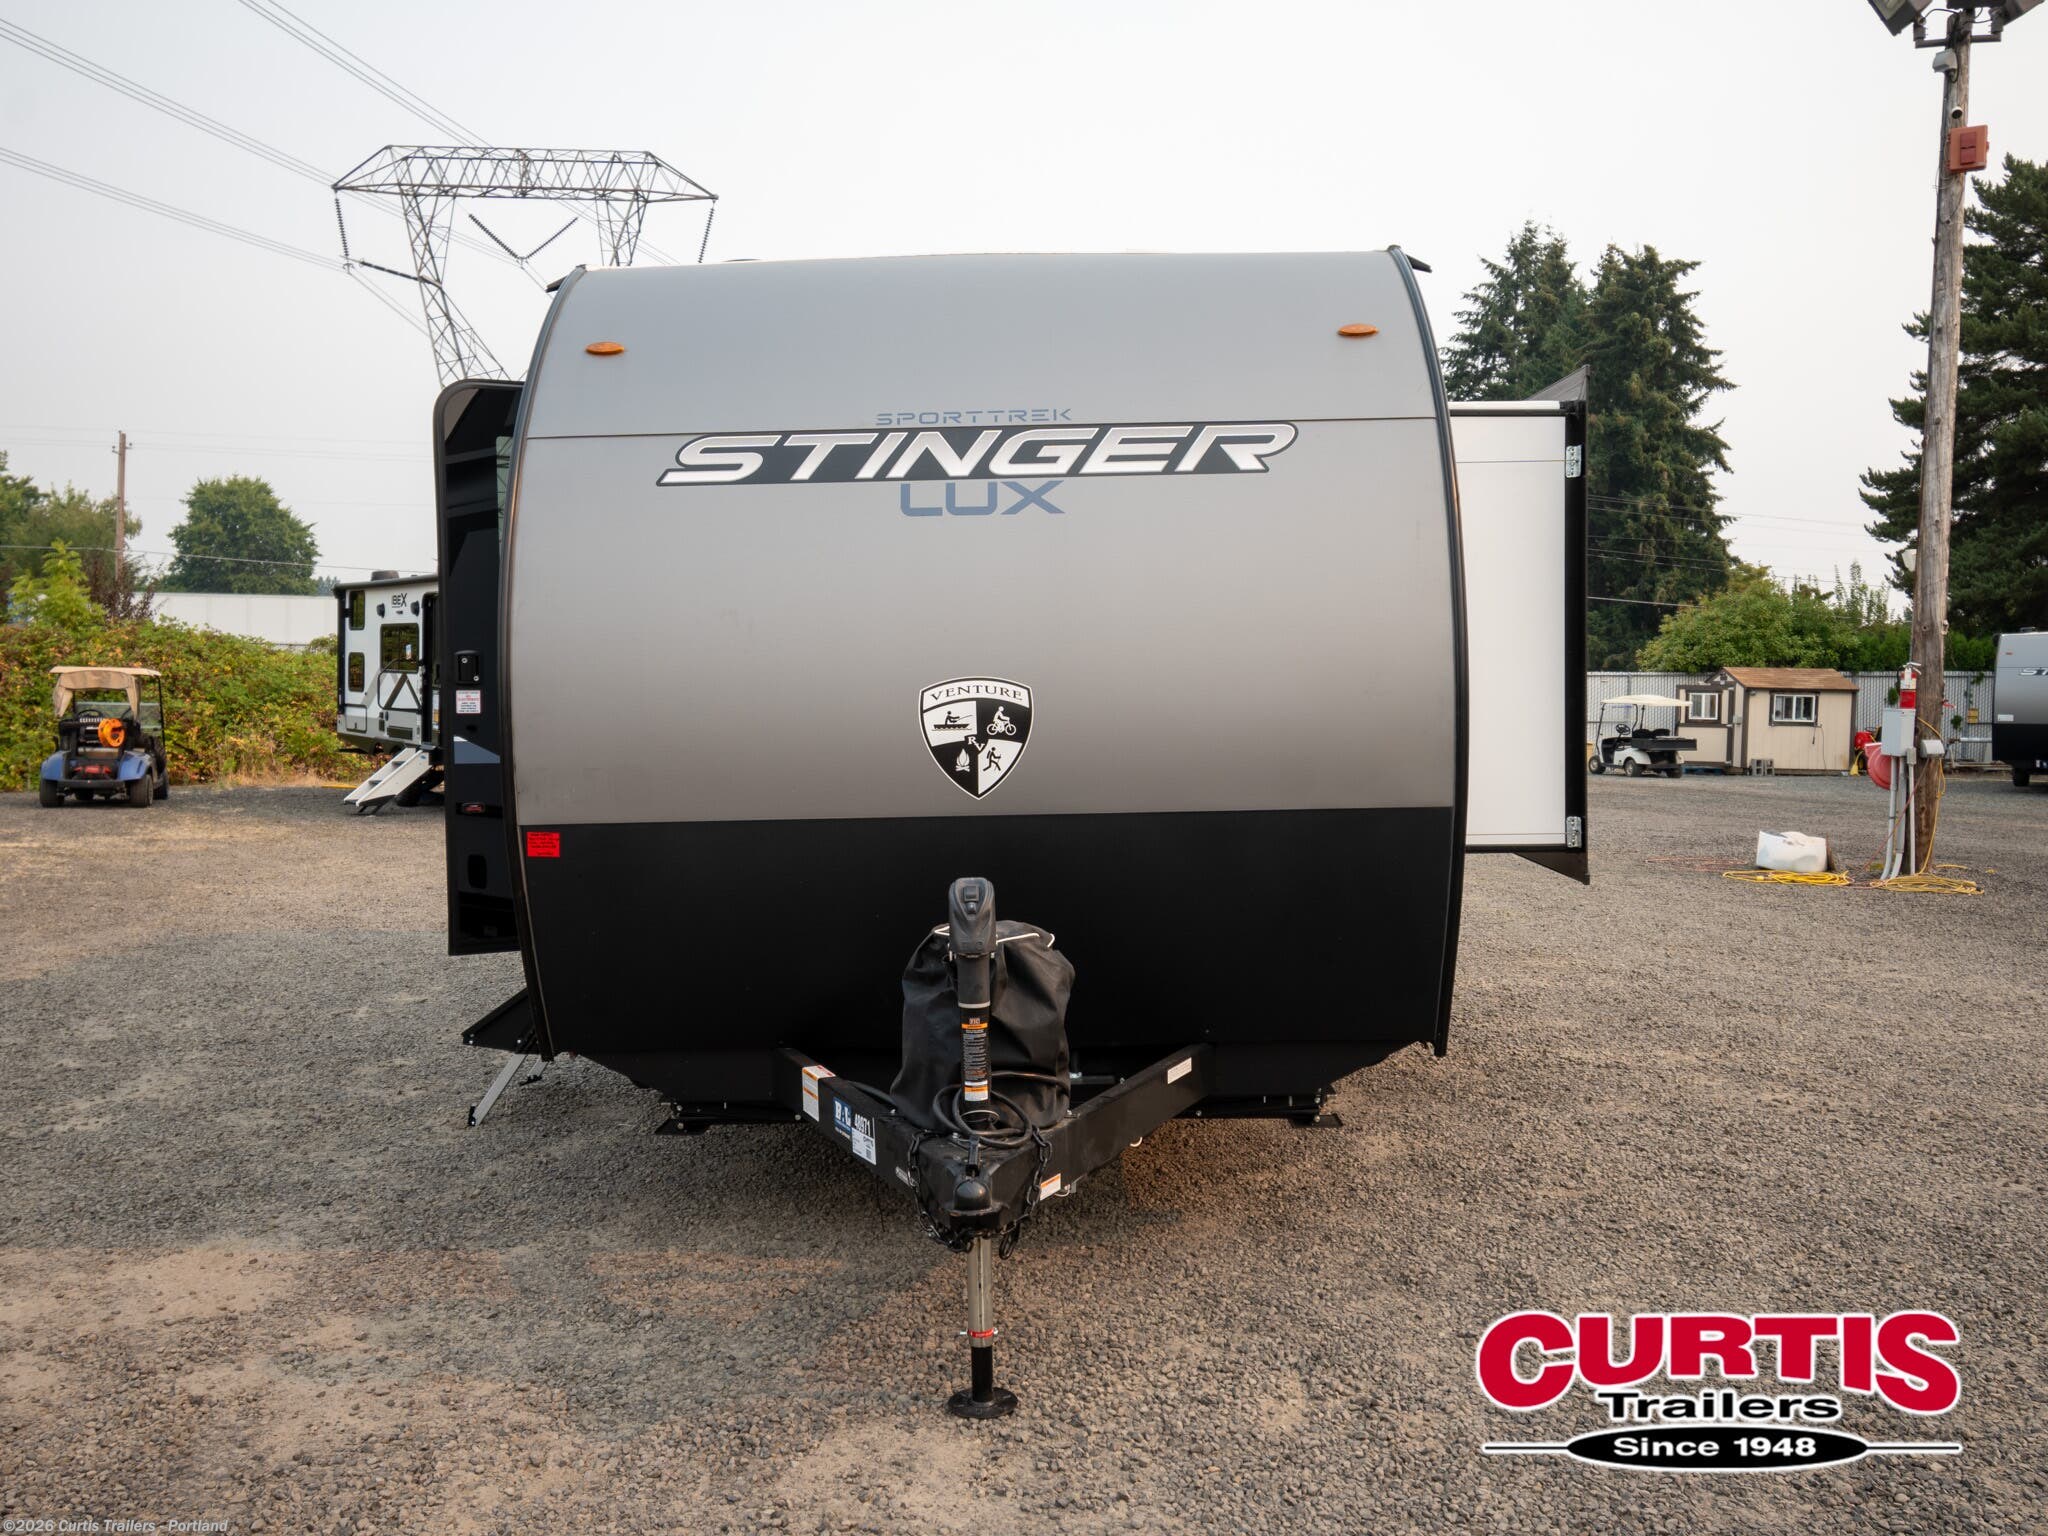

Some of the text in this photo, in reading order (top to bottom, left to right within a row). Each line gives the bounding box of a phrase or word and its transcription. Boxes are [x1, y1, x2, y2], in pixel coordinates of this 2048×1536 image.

[875, 408, 1072, 426] SPORTTREK
[657, 420, 1298, 486] STINGER
[900, 479, 1066, 517] LUX
[930, 684, 1023, 701] VENTURE
[967, 735, 986, 752] RV
